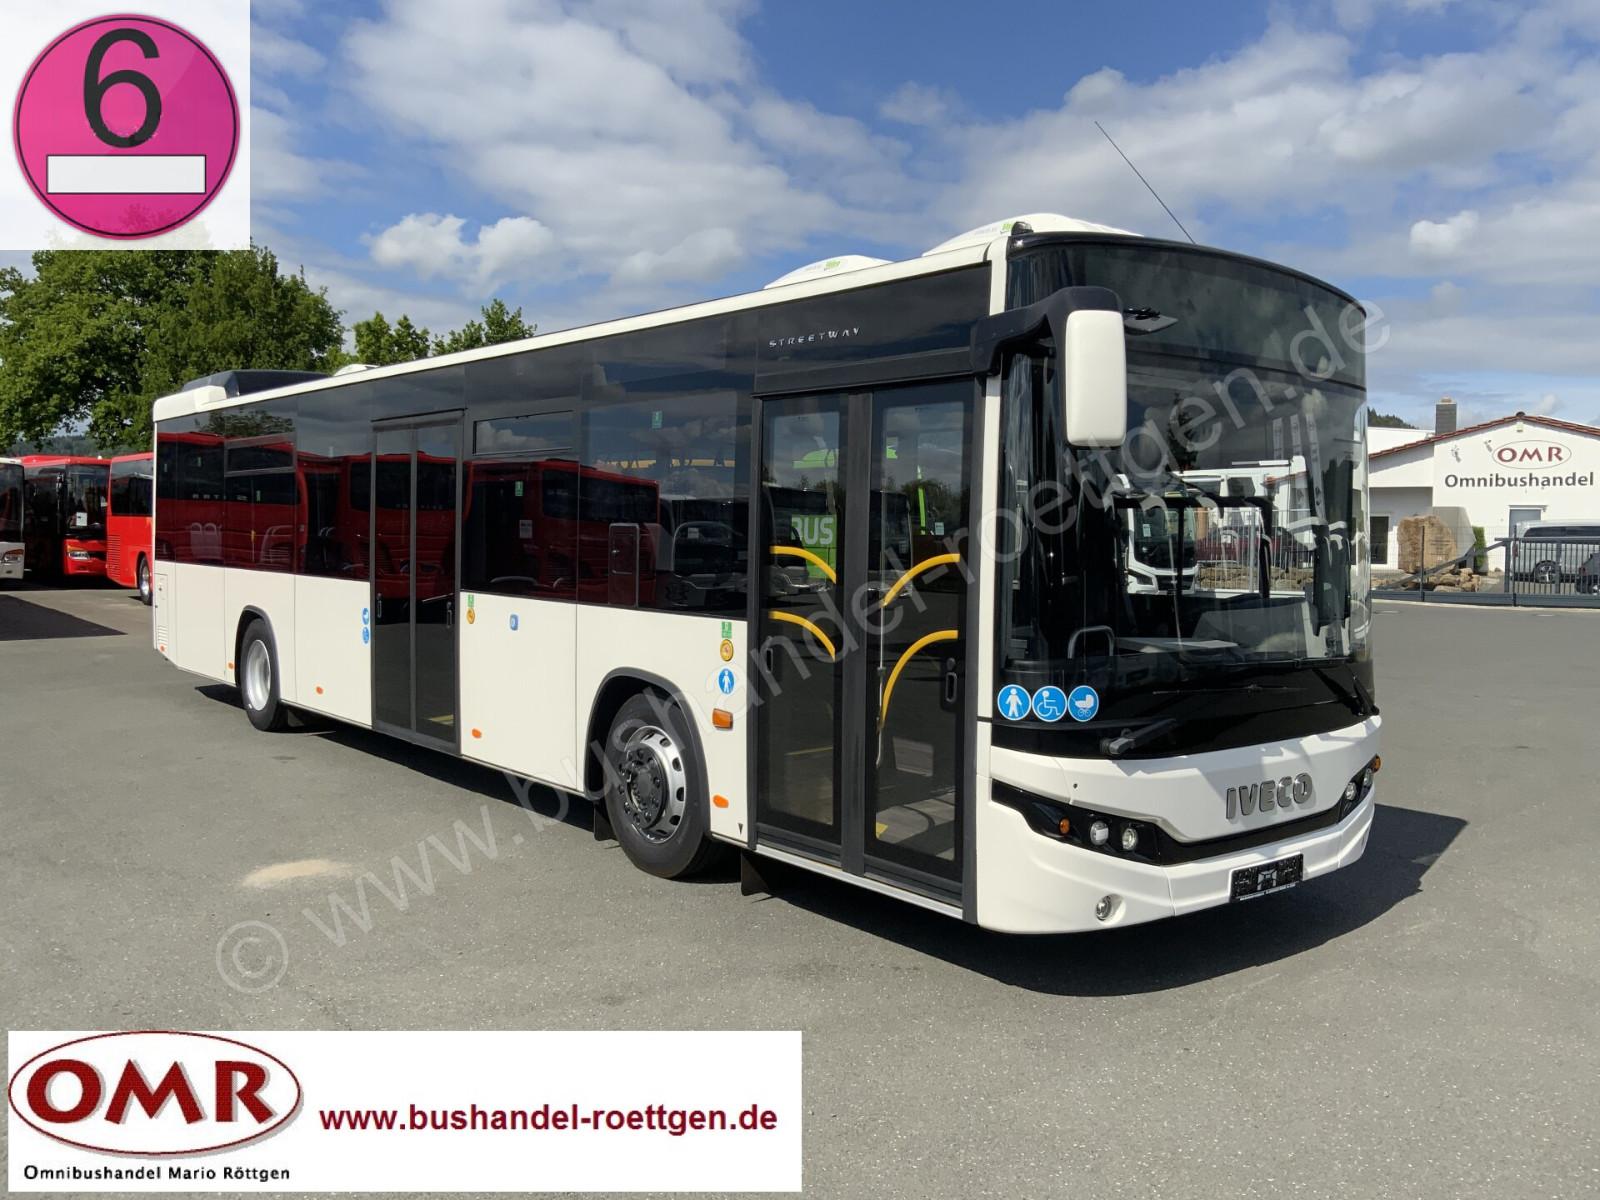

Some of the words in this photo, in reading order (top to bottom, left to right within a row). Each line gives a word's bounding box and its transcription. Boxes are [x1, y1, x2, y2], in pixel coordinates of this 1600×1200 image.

[769, 327, 860, 348] STREETWAY
[1497, 446, 1563, 463] OMR
[1444, 472, 1594, 488] Omnibushandel
[1226, 772, 1313, 820] IVECO
